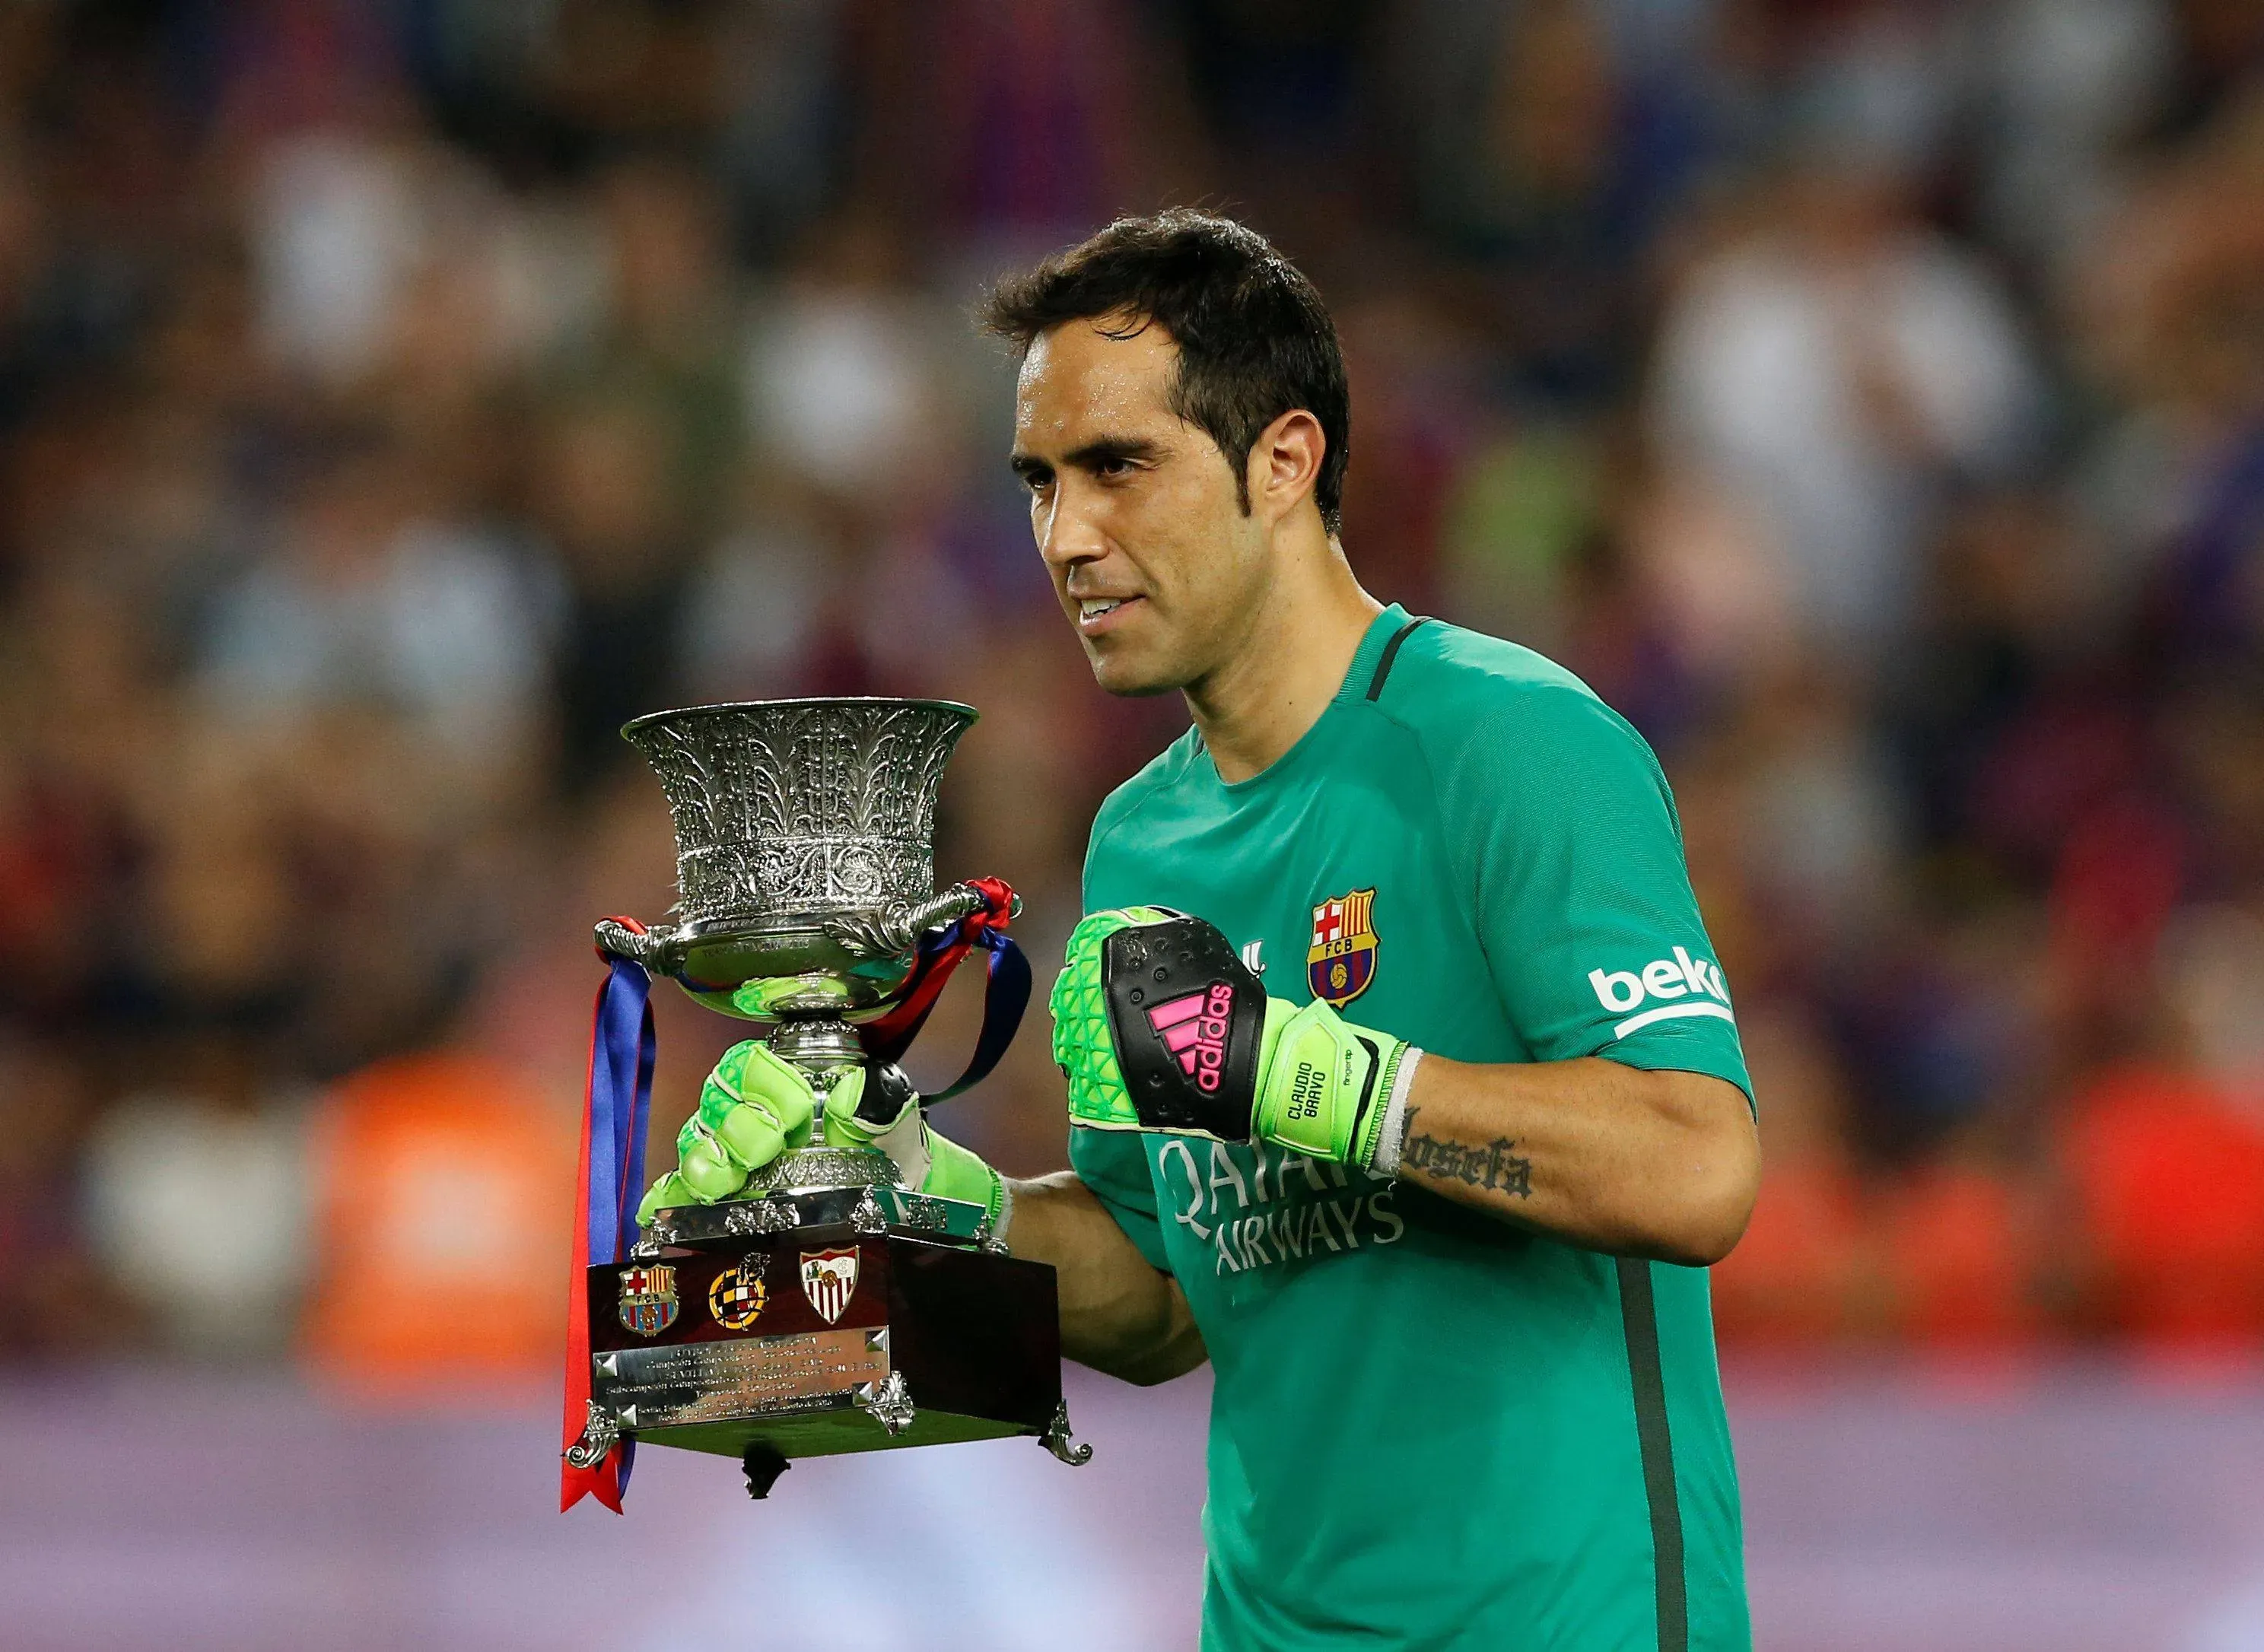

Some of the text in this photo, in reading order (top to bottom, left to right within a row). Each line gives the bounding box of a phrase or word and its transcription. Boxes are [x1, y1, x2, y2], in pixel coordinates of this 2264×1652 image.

[1325, 938, 1353, 958] FCB
[1195, 985, 1232, 1091] adidas
[1287, 1062, 1312, 1120] CLAUDIO
[1304, 1072, 1326, 1118] BRAVO
[1216, 1191, 1404, 1276] AIRWAYS
